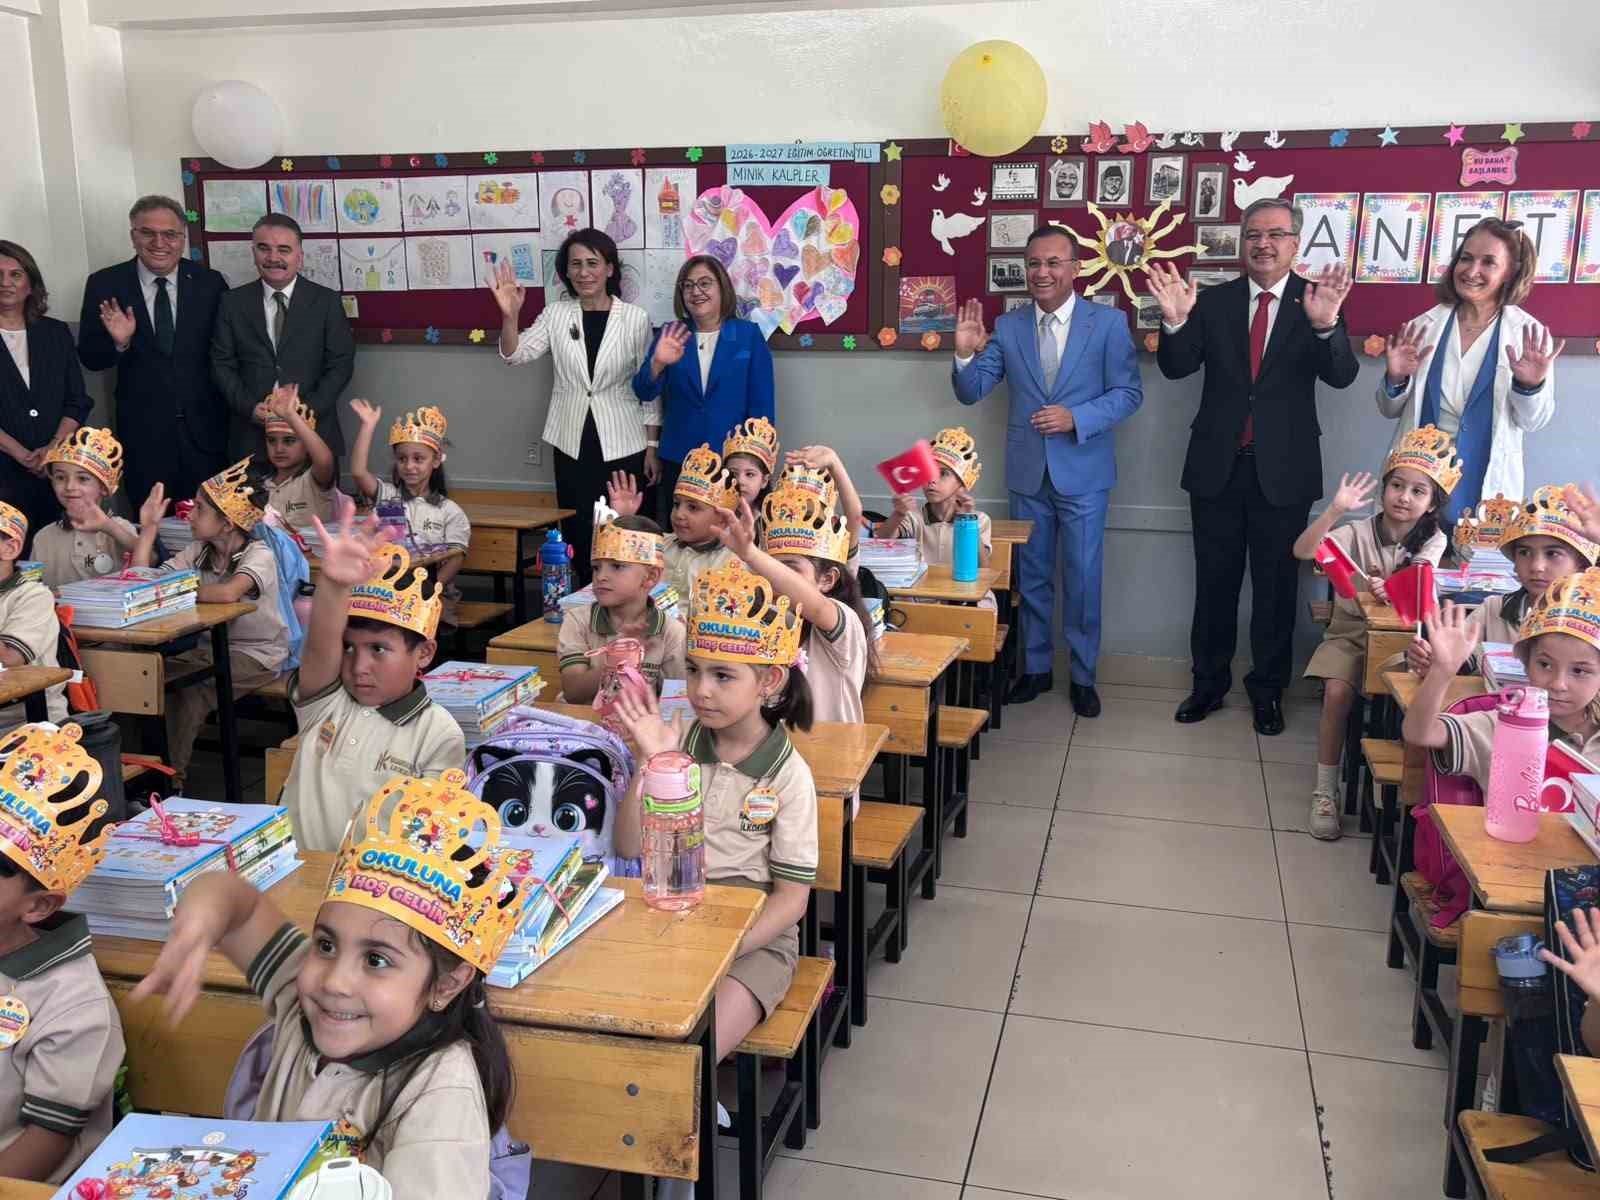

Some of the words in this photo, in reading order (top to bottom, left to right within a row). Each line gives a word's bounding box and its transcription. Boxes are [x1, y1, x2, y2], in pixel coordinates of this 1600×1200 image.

[772, 167, 821, 183] KALPLER
[698, 622, 761, 639] OKULUNA
[696, 639, 718, 653] HOŞ
[361, 849, 463, 904] OKULUNA
[350, 874, 389, 898] HOŞ
[388, 886, 448, 926] GELDİN
